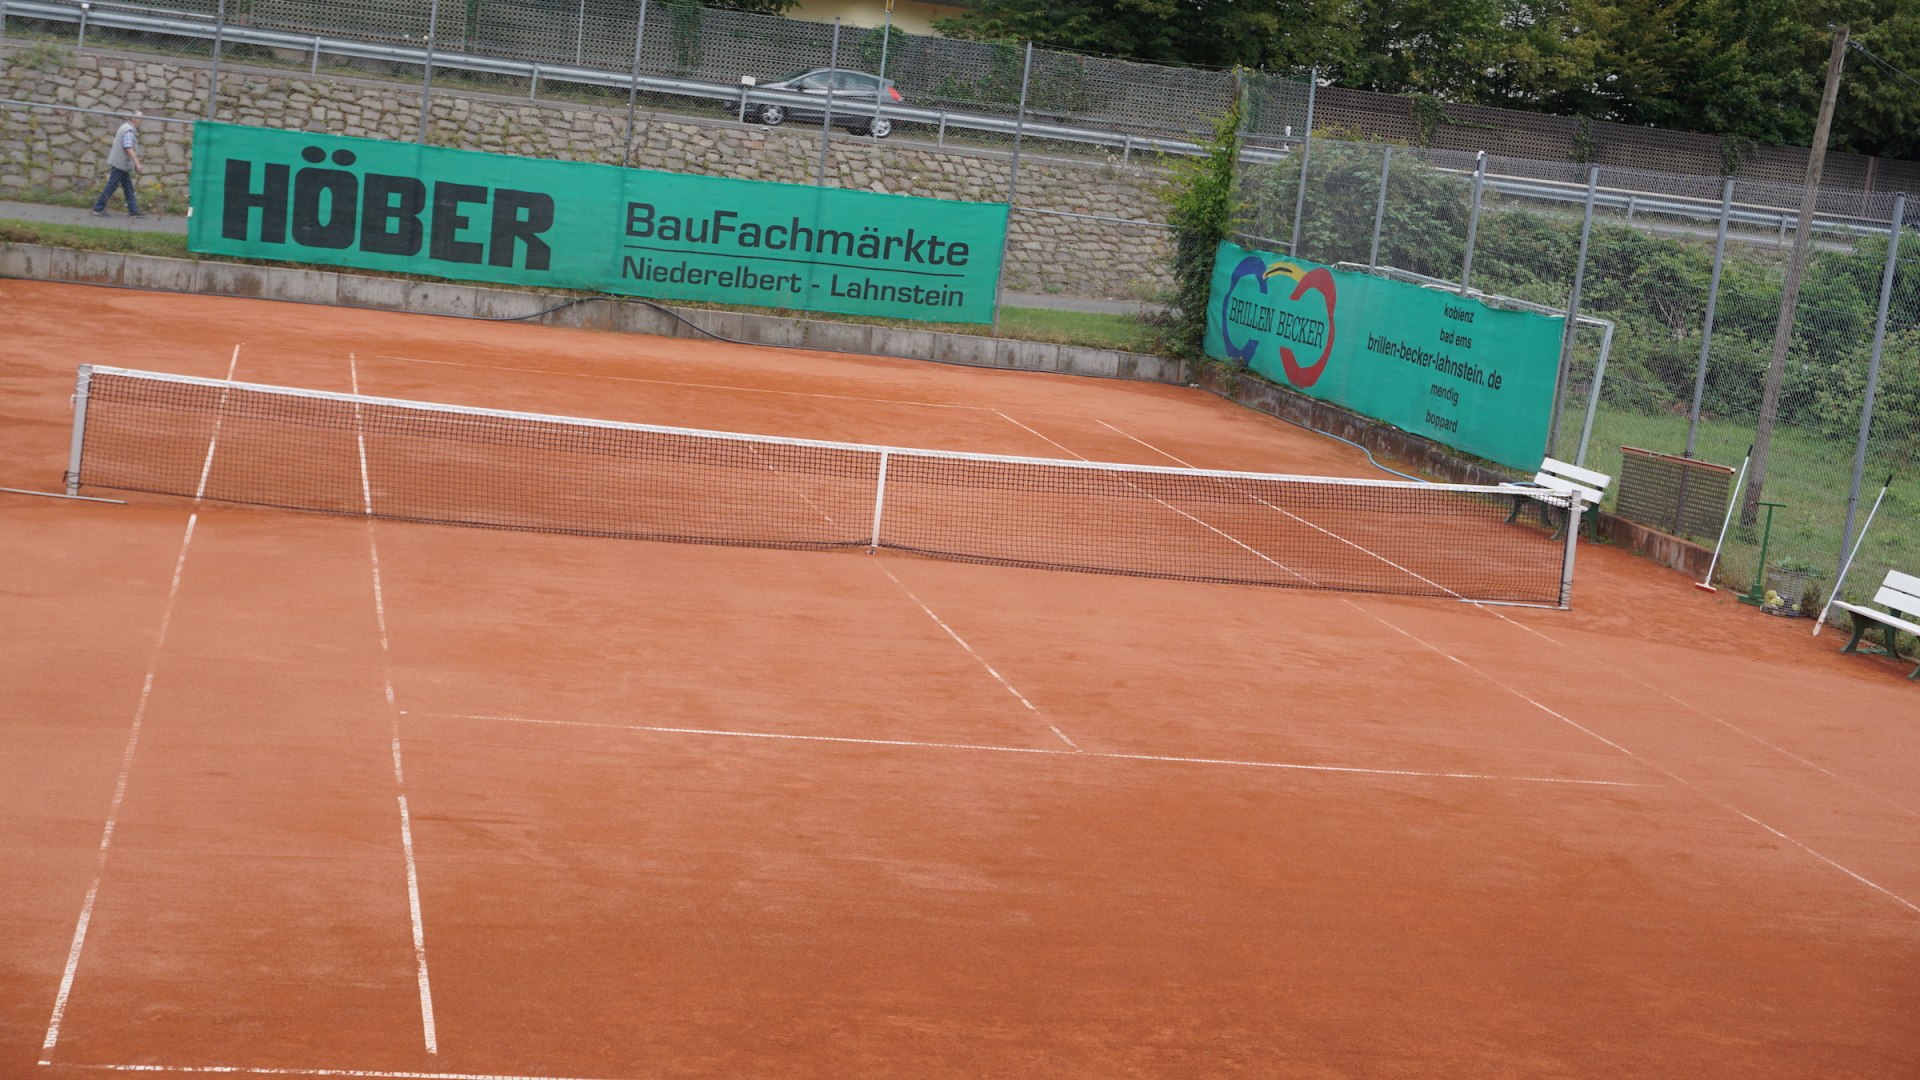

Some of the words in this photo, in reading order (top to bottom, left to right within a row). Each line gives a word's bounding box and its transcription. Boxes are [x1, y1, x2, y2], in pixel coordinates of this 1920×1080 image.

[221, 146, 555, 271] HÖBER
[625, 202, 970, 267] BauFachmärkte
[621, 255, 802, 295] Niederelbert
[831, 274, 965, 307] Lahnstein
[1229, 297, 1275, 333] BRILLEN
[1276, 311, 1325, 349] BECKER
[1444, 302, 1475, 324] koblenz
[1439, 327, 1455, 345] bad
[1455, 335, 1472, 349] ems
[1430, 382, 1460, 407] mendig
[1425, 408, 1459, 434] boppard
